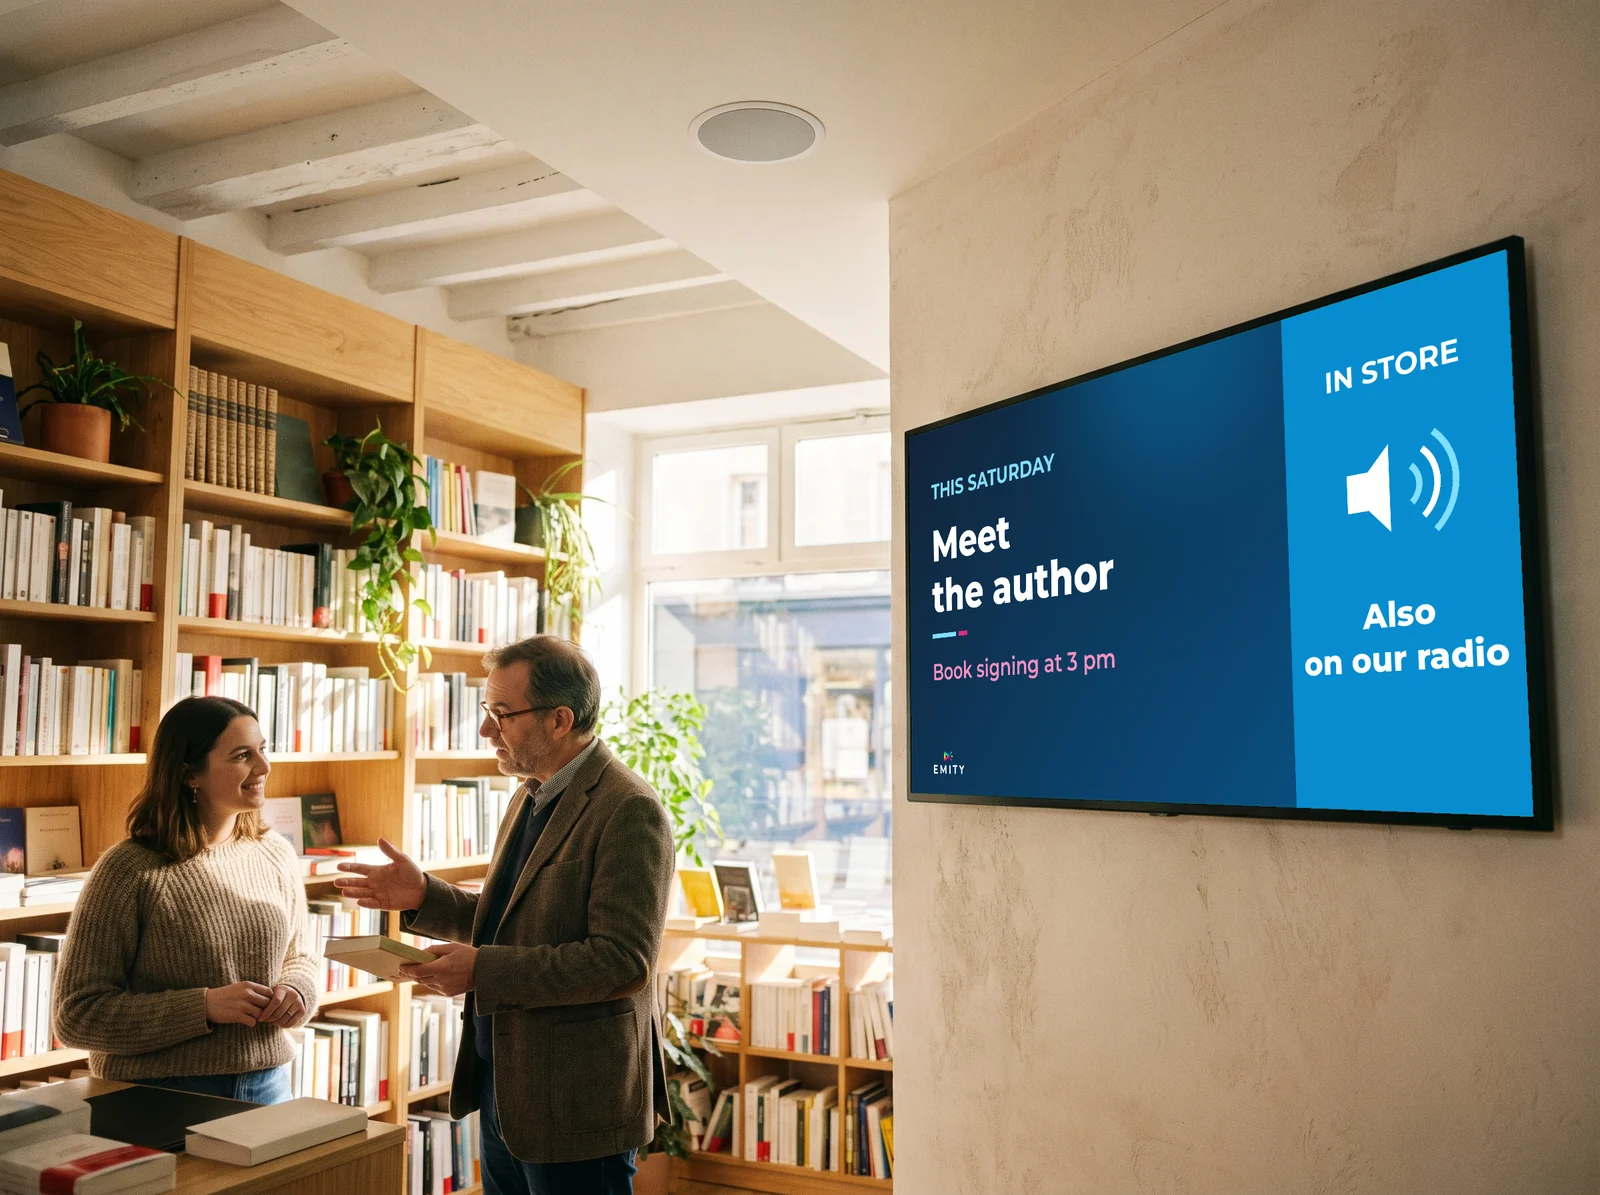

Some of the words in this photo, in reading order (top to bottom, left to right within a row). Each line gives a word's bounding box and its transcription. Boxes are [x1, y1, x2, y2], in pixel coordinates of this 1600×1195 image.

[1325, 366, 1353, 394] IN
[1361, 338, 1459, 385] STORE
[930, 477, 964, 500] THIS
[967, 452, 1055, 491] SATURDAY
[932, 516, 1011, 563] Meet
[931, 576, 984, 613] the
[992, 558, 1114, 605] author
[1362, 600, 1436, 630] Also
[933, 659, 973, 681] Book
[976, 656, 1039, 682] signing
[1044, 654, 1063, 673] at
[1066, 651, 1078, 672] 3
[1083, 652, 1116, 676] pm
[1304, 655, 1343, 677] on
[1352, 650, 1407, 674] our
[1417, 635, 1510, 671] radio
[933, 764, 965, 775] EMITY
